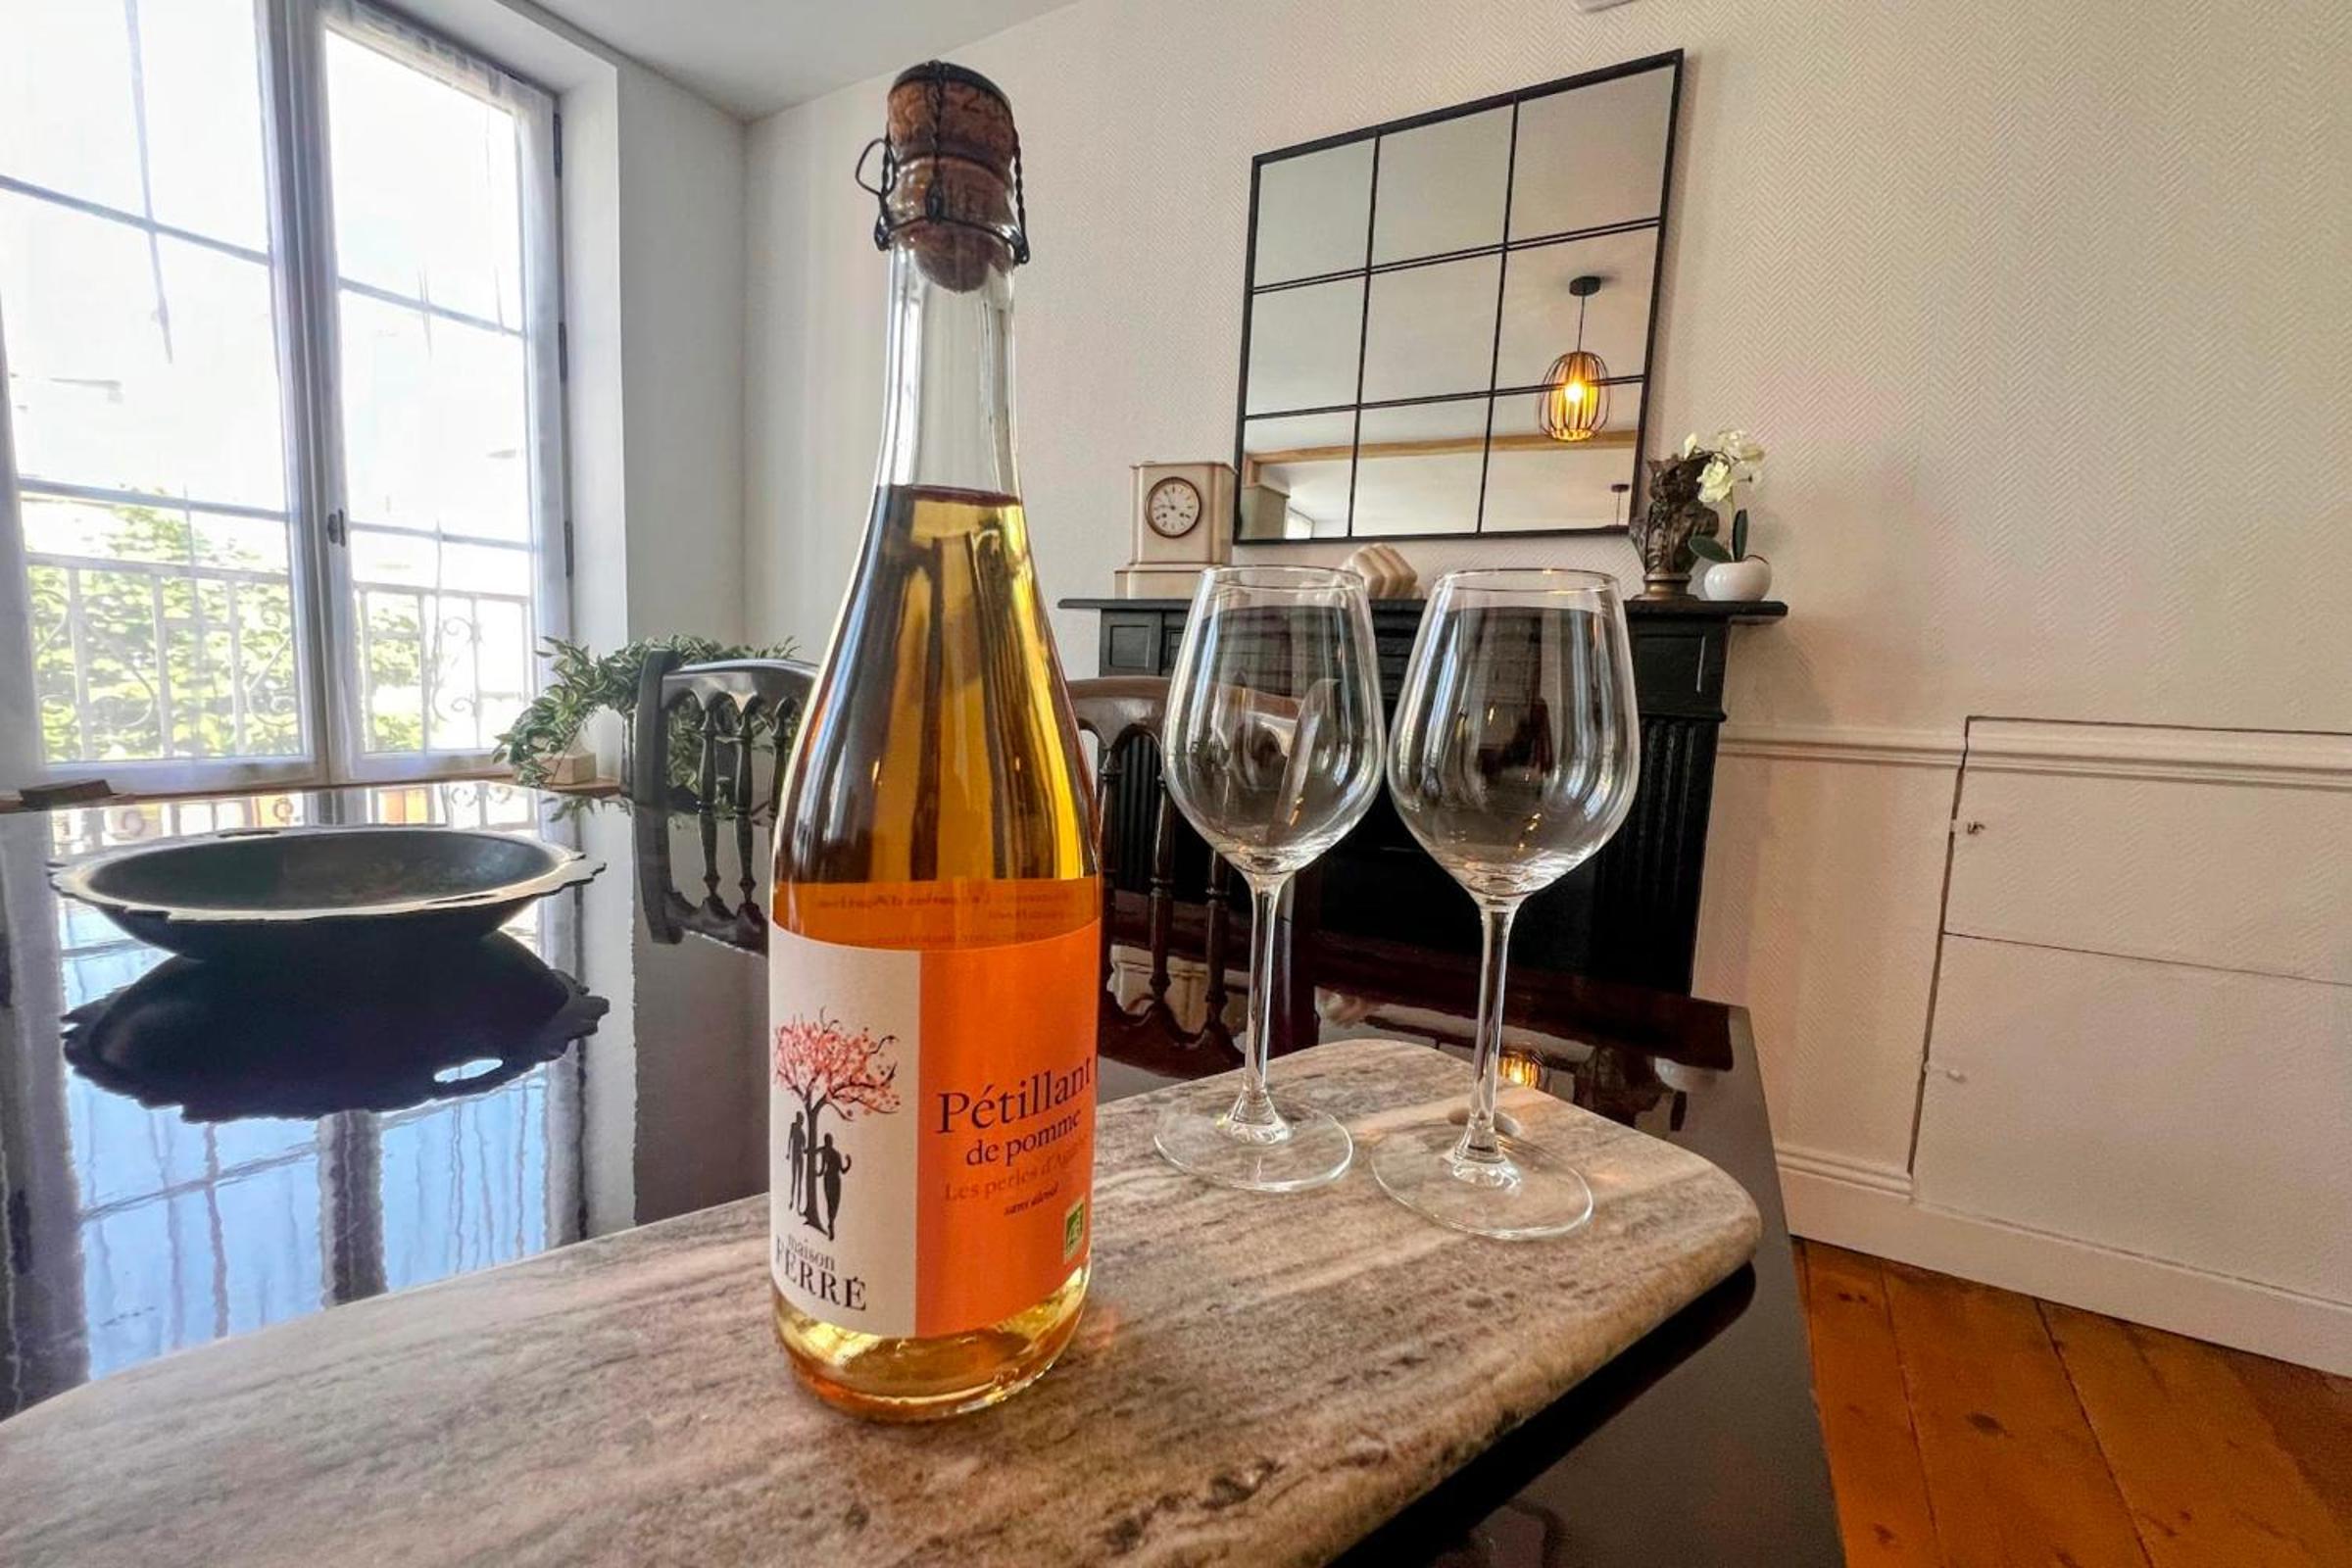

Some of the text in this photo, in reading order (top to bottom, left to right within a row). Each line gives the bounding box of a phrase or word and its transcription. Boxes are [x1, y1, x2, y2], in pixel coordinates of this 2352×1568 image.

[934, 1057, 1091, 1134] Pétillant
[965, 1109, 1081, 1166] de pomme
[945, 1183, 980, 1200] Les
